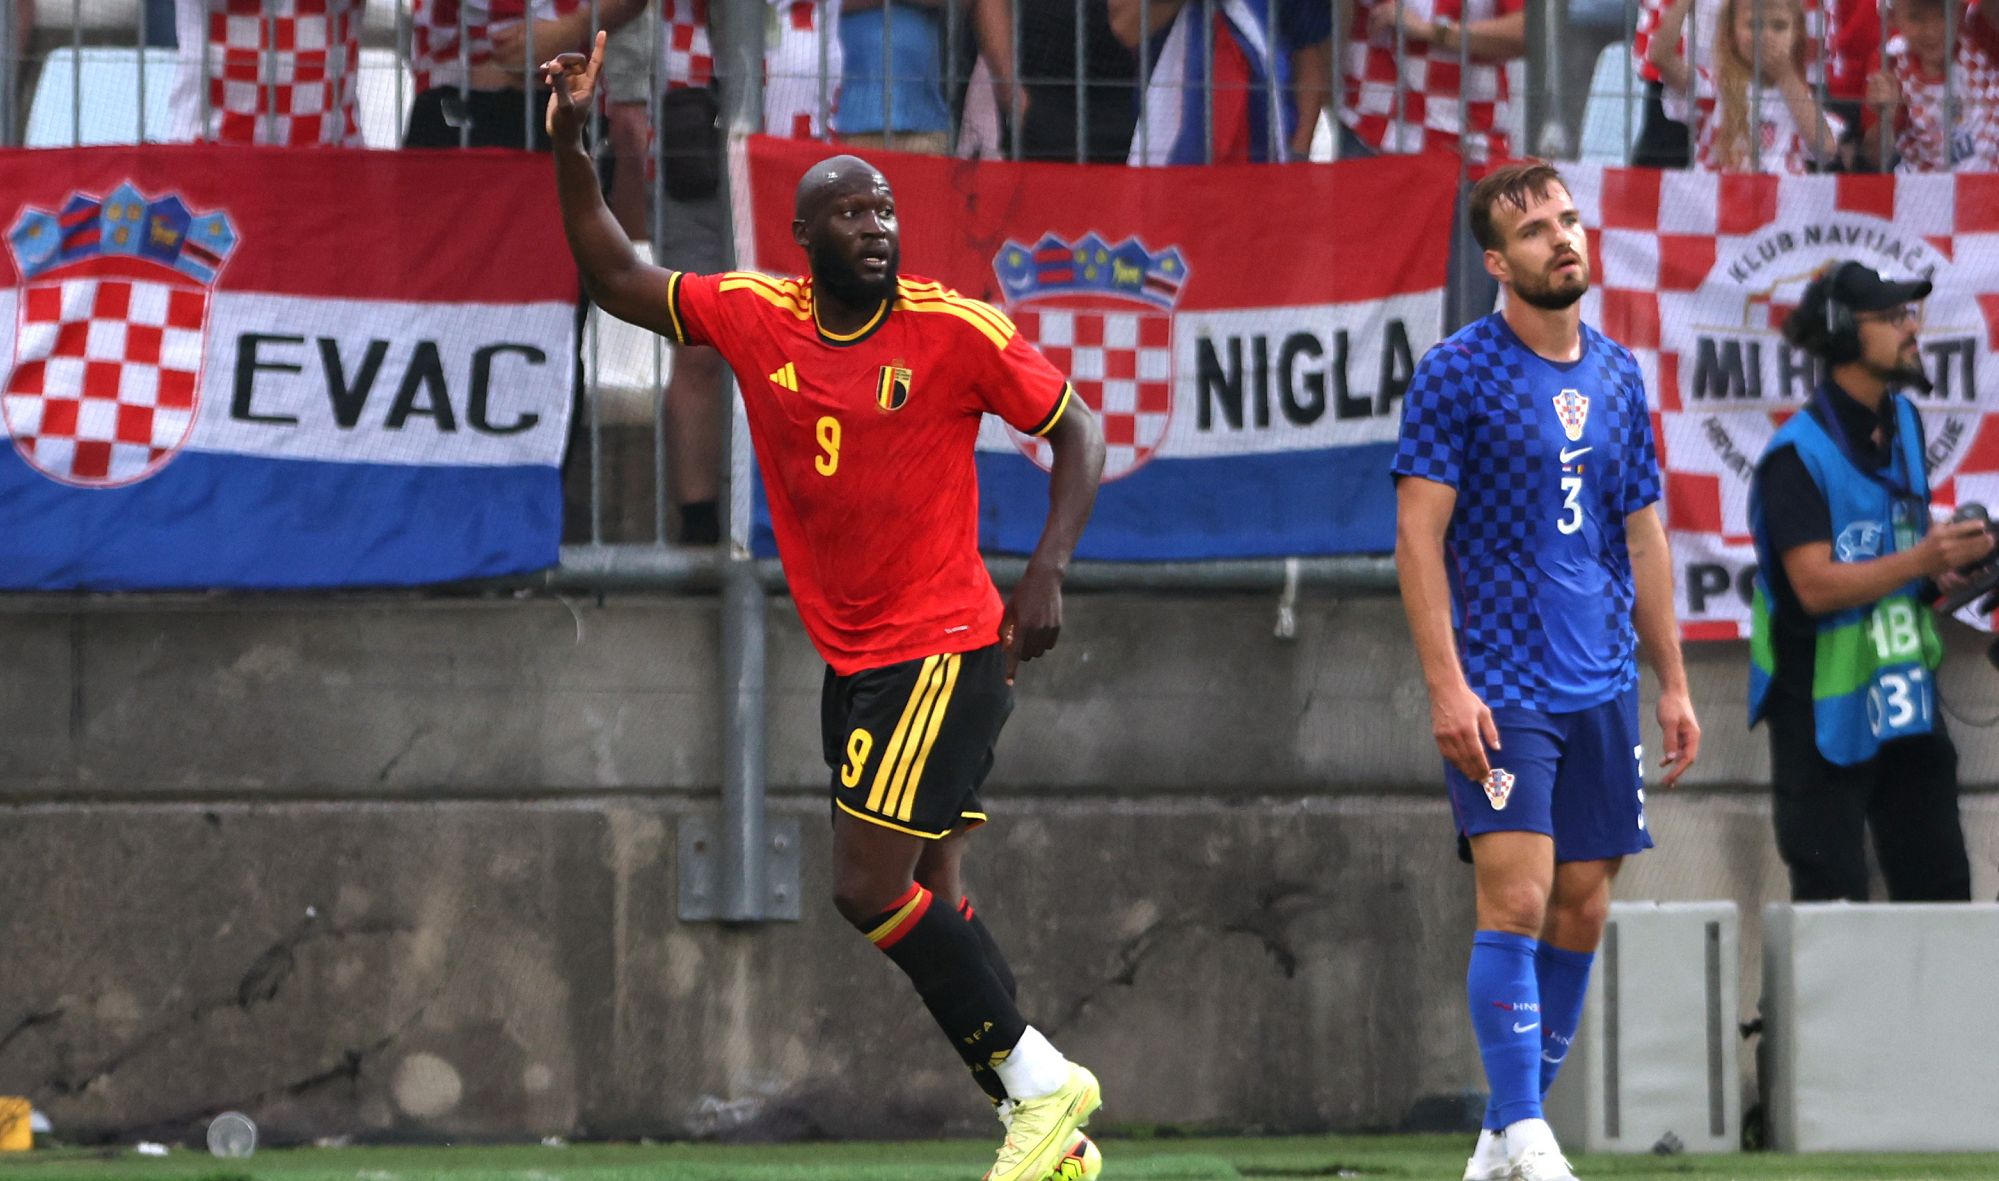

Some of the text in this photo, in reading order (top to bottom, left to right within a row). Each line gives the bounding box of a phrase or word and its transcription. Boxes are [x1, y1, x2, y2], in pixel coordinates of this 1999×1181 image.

[1728, 231, 1794, 284] KLUB
[230, 332, 546, 437] EVAC
[1195, 319, 1416, 431] NIGLA
[1692, 336, 1762, 399] MI
[815, 416, 841, 476] 9
[1557, 477, 1582, 534] 3
[841, 728, 873, 788] 9
